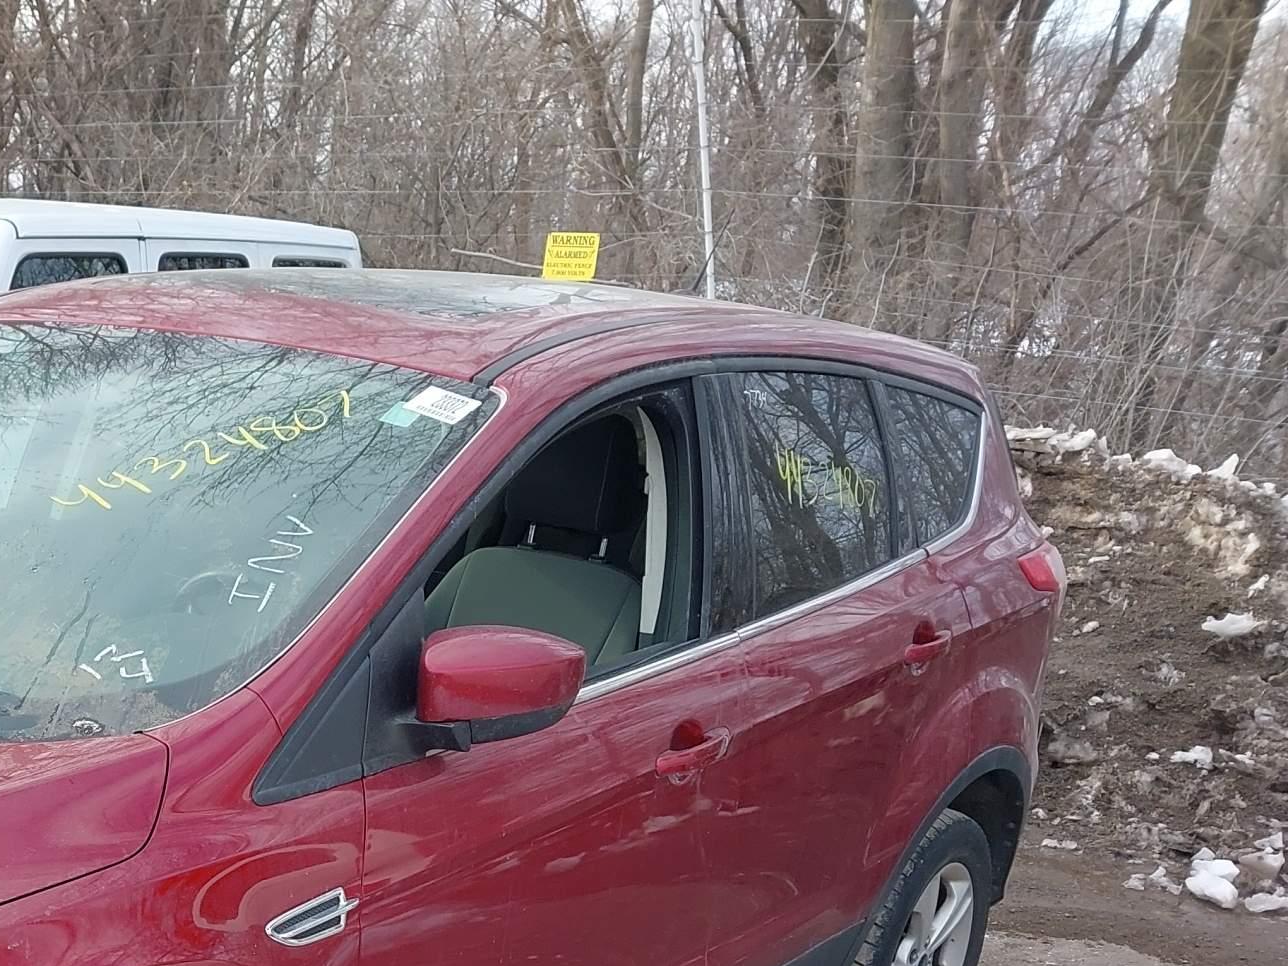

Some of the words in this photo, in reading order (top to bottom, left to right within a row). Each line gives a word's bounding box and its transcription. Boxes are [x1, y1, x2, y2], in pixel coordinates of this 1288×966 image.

[552, 234, 596, 246] WARNING
[554, 250, 589, 259] ALARMED
[50, 390, 351, 510] 44324807
[775, 439, 876, 518] 44324807
[228, 515, 314, 613] INV
